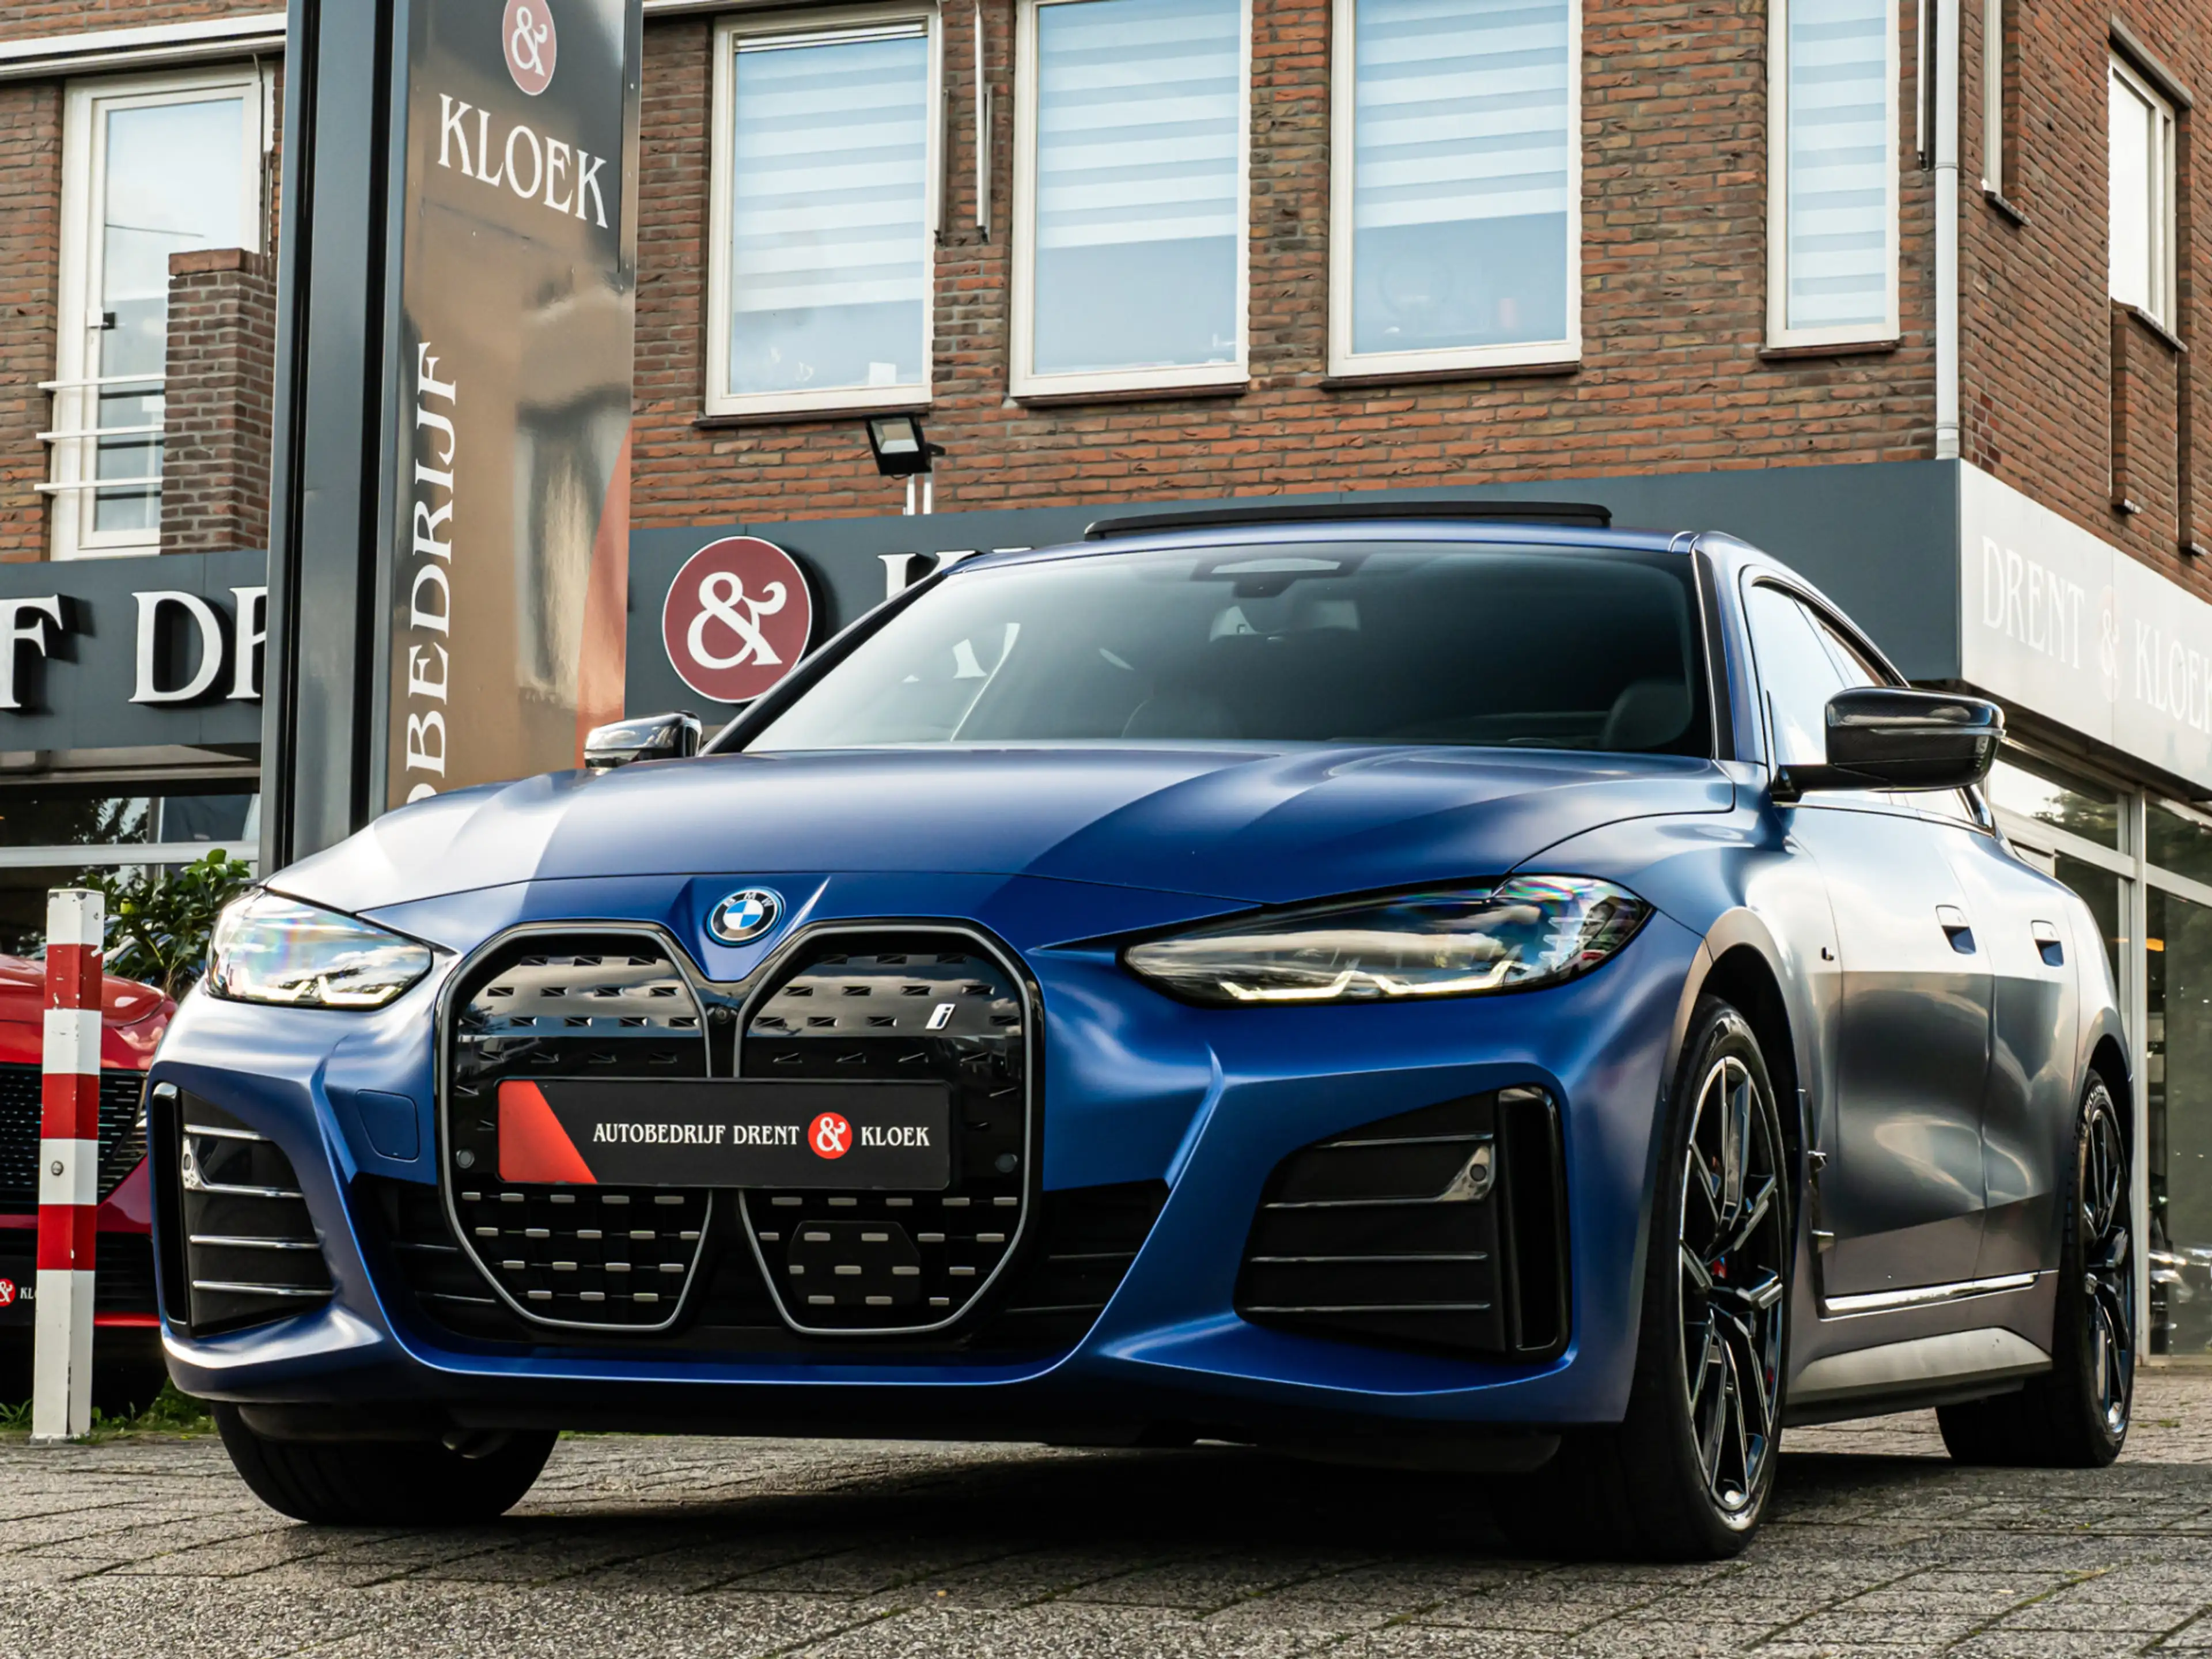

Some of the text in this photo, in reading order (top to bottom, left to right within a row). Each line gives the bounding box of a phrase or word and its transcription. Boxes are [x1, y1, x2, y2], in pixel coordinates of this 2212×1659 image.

[511, 6, 547, 77] &
[437, 93, 608, 229] KLOEK
[687, 571, 787, 669] &
[1982, 535, 2085, 670] DRENT
[2101, 608, 2120, 679] &
[723, 891, 774, 908] BMW
[593, 1116, 931, 1152] AUTOBEDRIJF DRENT & KLOEK
[20, 1287, 36, 1300] KL
